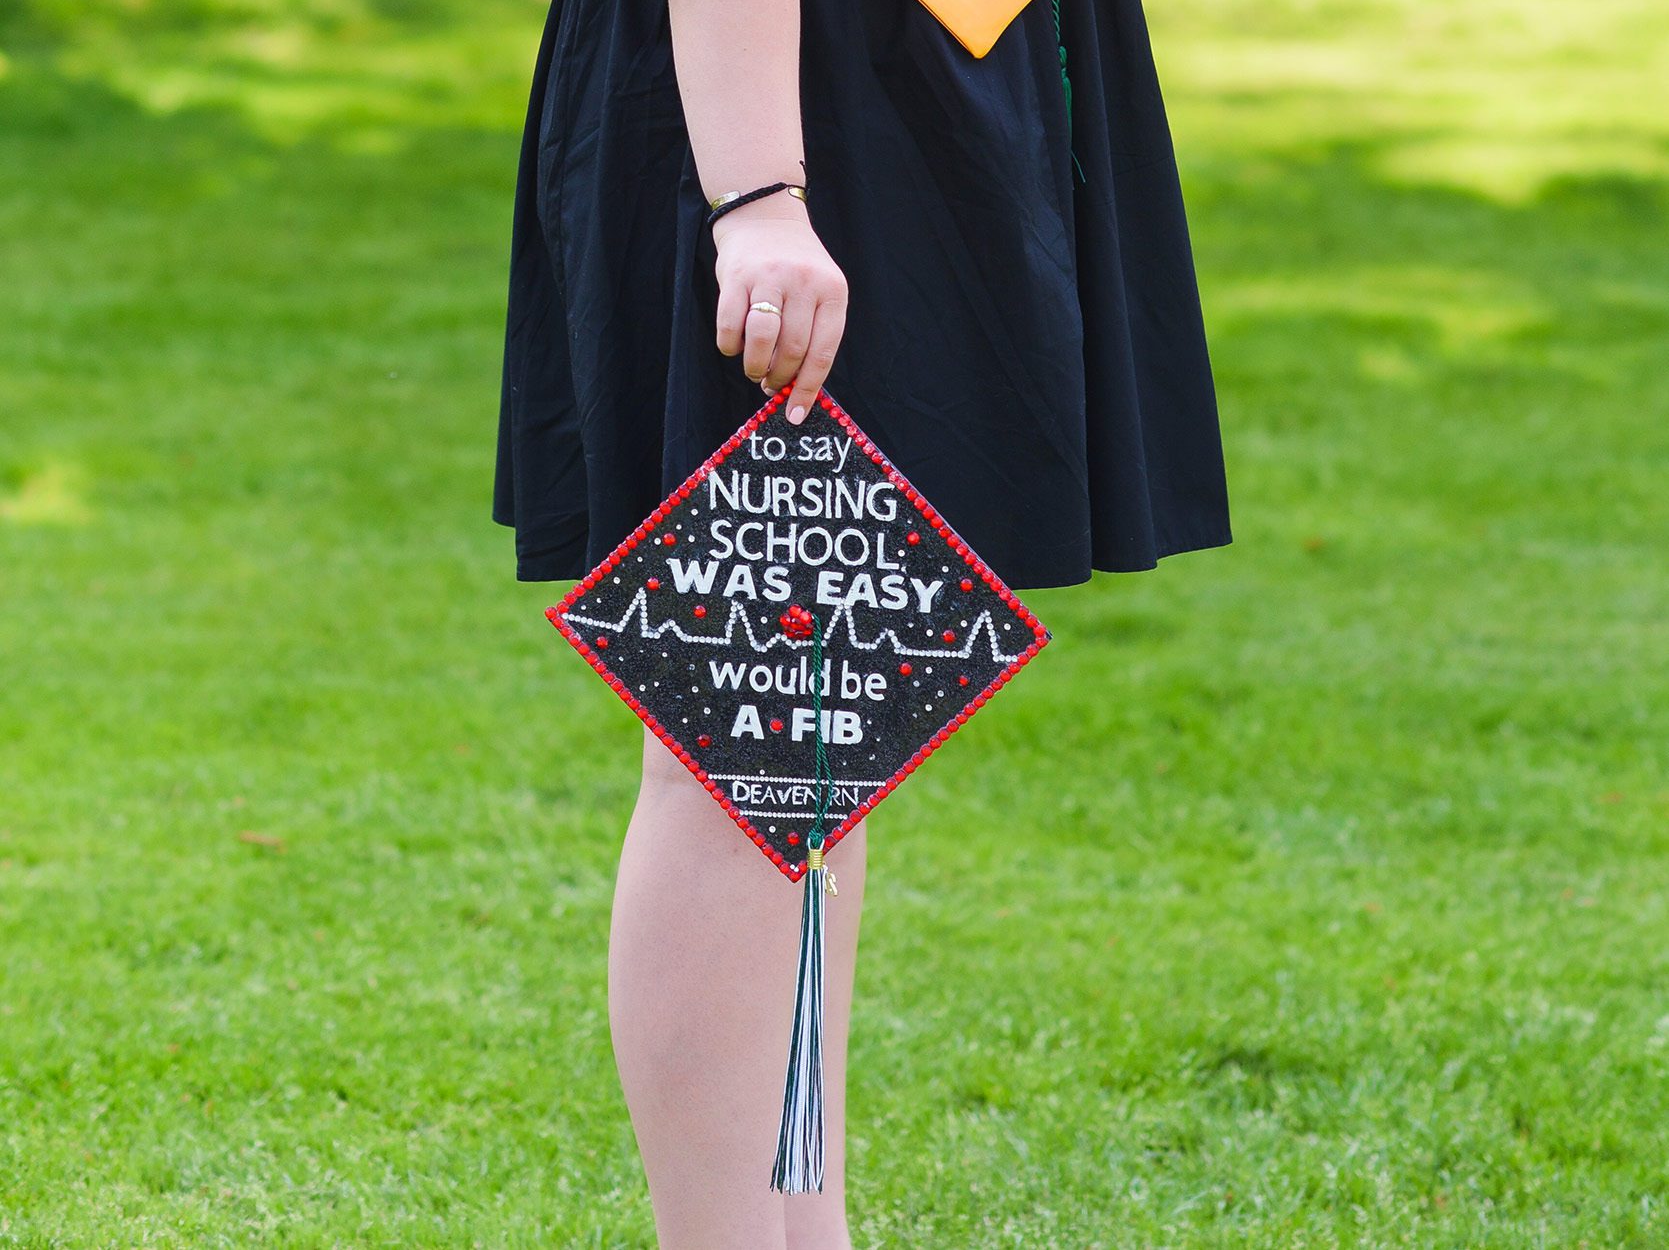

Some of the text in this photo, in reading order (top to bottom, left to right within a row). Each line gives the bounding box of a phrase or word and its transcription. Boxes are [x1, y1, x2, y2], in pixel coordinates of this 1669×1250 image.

[750, 431, 852, 473] to say
[708, 470, 897, 521] NURSING
[709, 519, 899, 570] SCHOOL
[667, 558, 944, 613] WAS EASY
[708, 656, 887, 701] would be
[730, 704, 863, 745] A FIB
